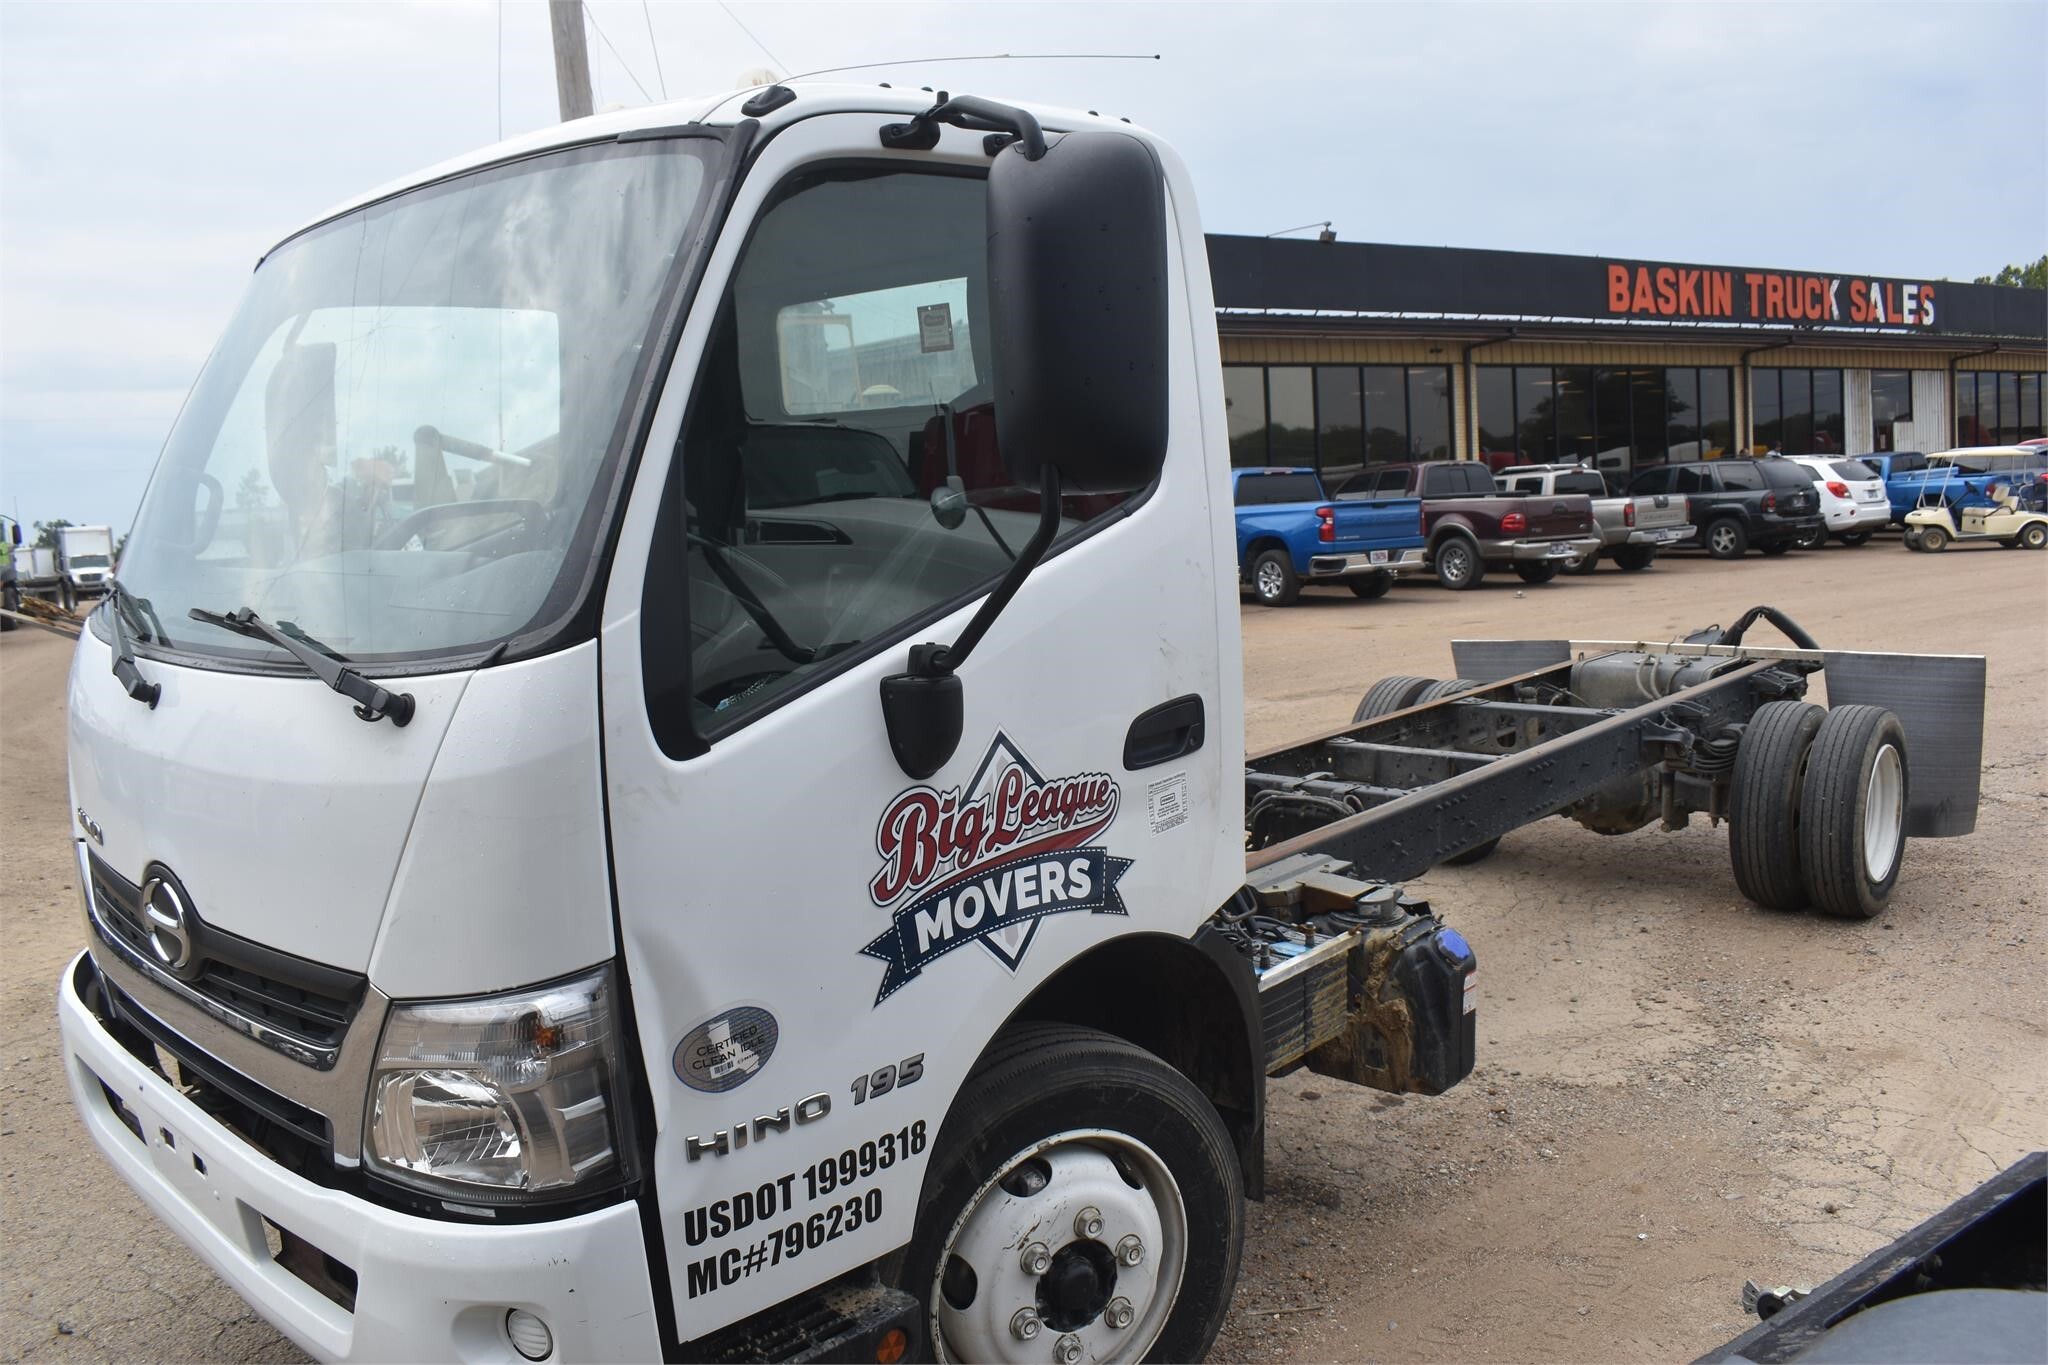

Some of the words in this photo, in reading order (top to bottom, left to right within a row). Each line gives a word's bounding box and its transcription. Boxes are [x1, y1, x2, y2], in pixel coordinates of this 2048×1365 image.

[1608, 264, 1732, 316] BASKIN
[1745, 273, 1841, 321] TRUCK
[1850, 279, 1935, 326] SALES
[870, 785, 990, 907] Big
[984, 761, 1115, 854] League
[914, 857, 1091, 954] MOVERS
[692, 1049, 737, 1070] CLEAN
[740, 1034, 765, 1053] IDLE
[696, 1025, 758, 1057] CERTIFIED
[685, 1091, 832, 1163] HINO
[850, 1052, 925, 1106] 195
[684, 1173, 796, 1247] USDOT
[802, 1119, 927, 1201] 1999318
[687, 1187, 883, 1300] MC#796230
